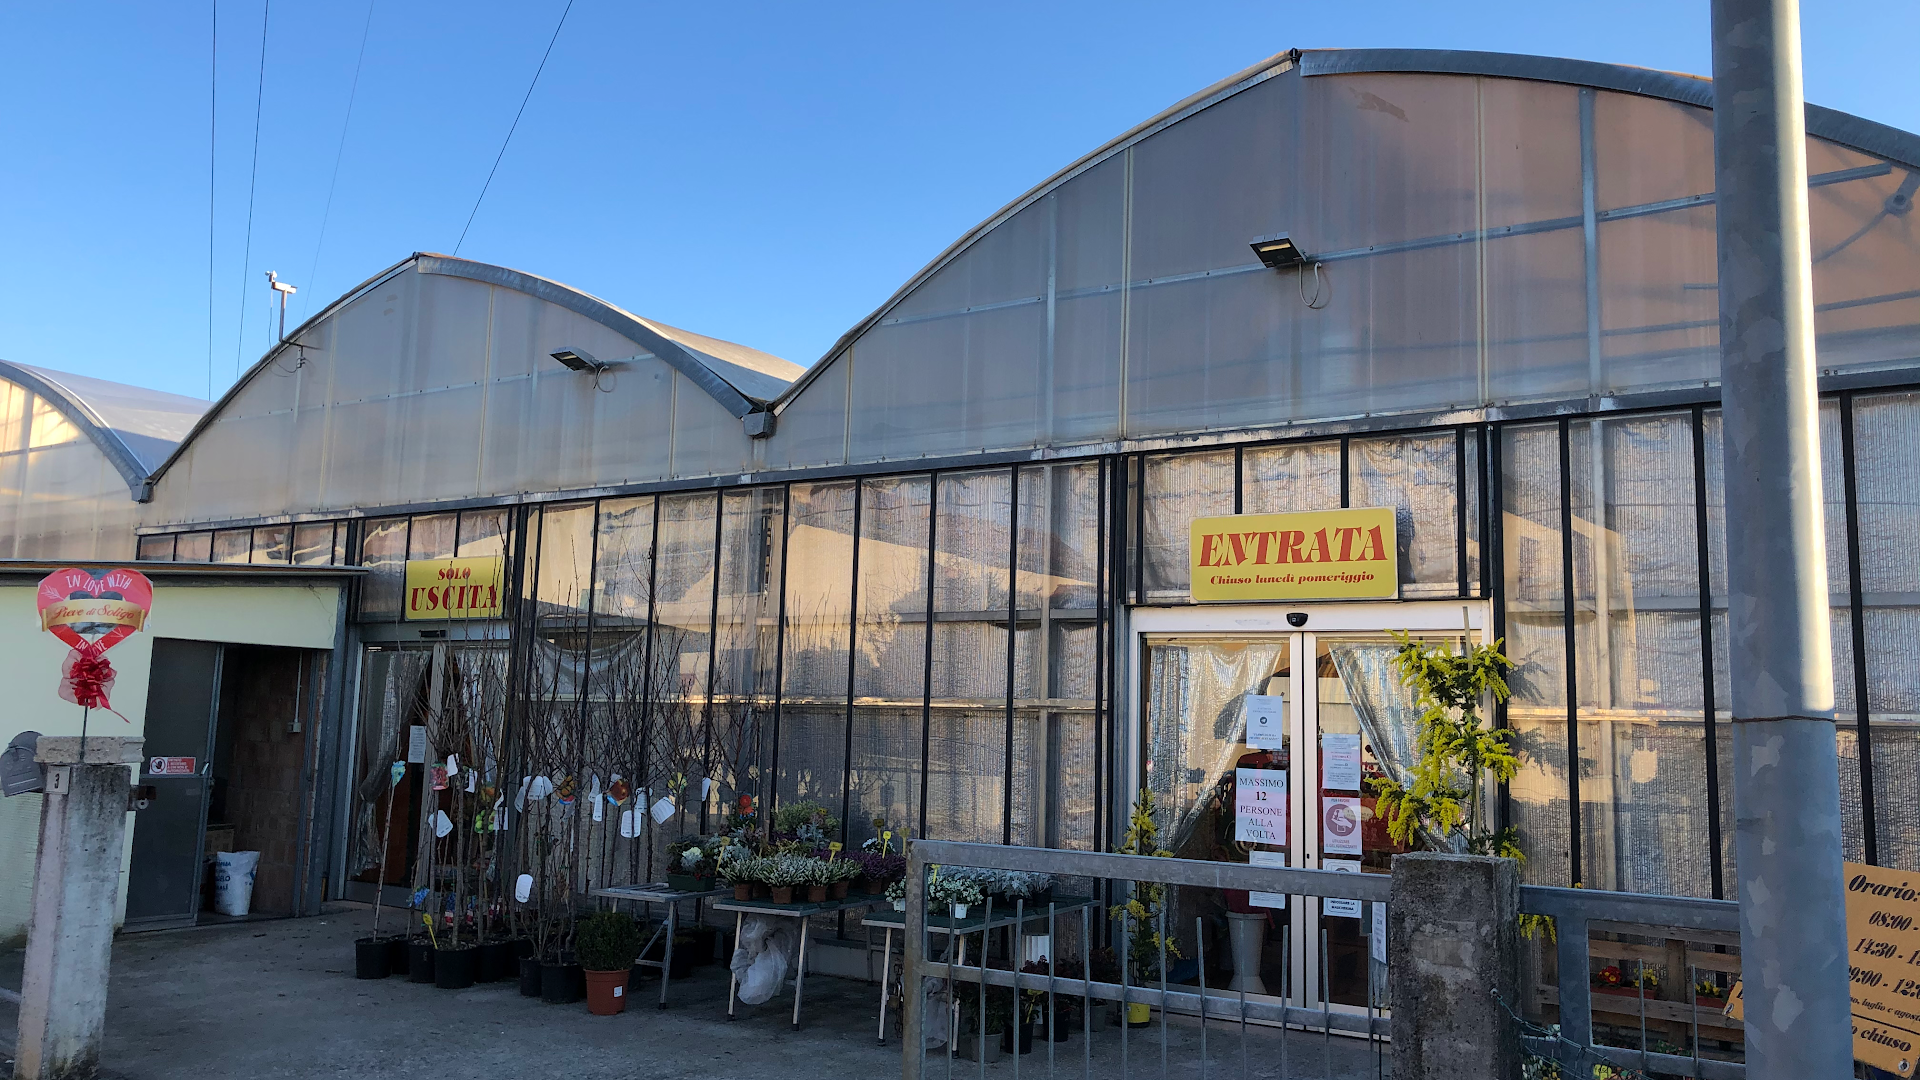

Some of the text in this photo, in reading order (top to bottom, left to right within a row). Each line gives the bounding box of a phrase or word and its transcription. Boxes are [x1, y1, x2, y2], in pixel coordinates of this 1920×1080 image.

[1198, 525, 1388, 568] ENTRATA
[437, 567, 471, 581] SOLO
[1210, 571, 1375, 586] Chiuso lunedì pomeriggio
[66, 573, 132, 595] IN LOVE WITH
[411, 584, 497, 612] USCITA
[54, 604, 135, 620] Pieve di Soligo
[75, 639, 89, 651] IN
[54, 773, 60, 789] 3
[1239, 777, 1284, 789] MASSIMO
[1256, 791, 1267, 801] 12
[1240, 805, 1283, 817] PERSONE
[1248, 818, 1274, 828] ALLA
[1246, 829, 1276, 840] VOLTA
[1849, 874, 1920, 903] Orario:
[1869, 910, 1913, 932] 08:00
[1854, 938, 1898, 959] 14:30
[1862, 998, 1886, 1011] luglio
[1894, 1009, 1920, 1022] agost
[1860, 1027, 1912, 1052] chiuso
